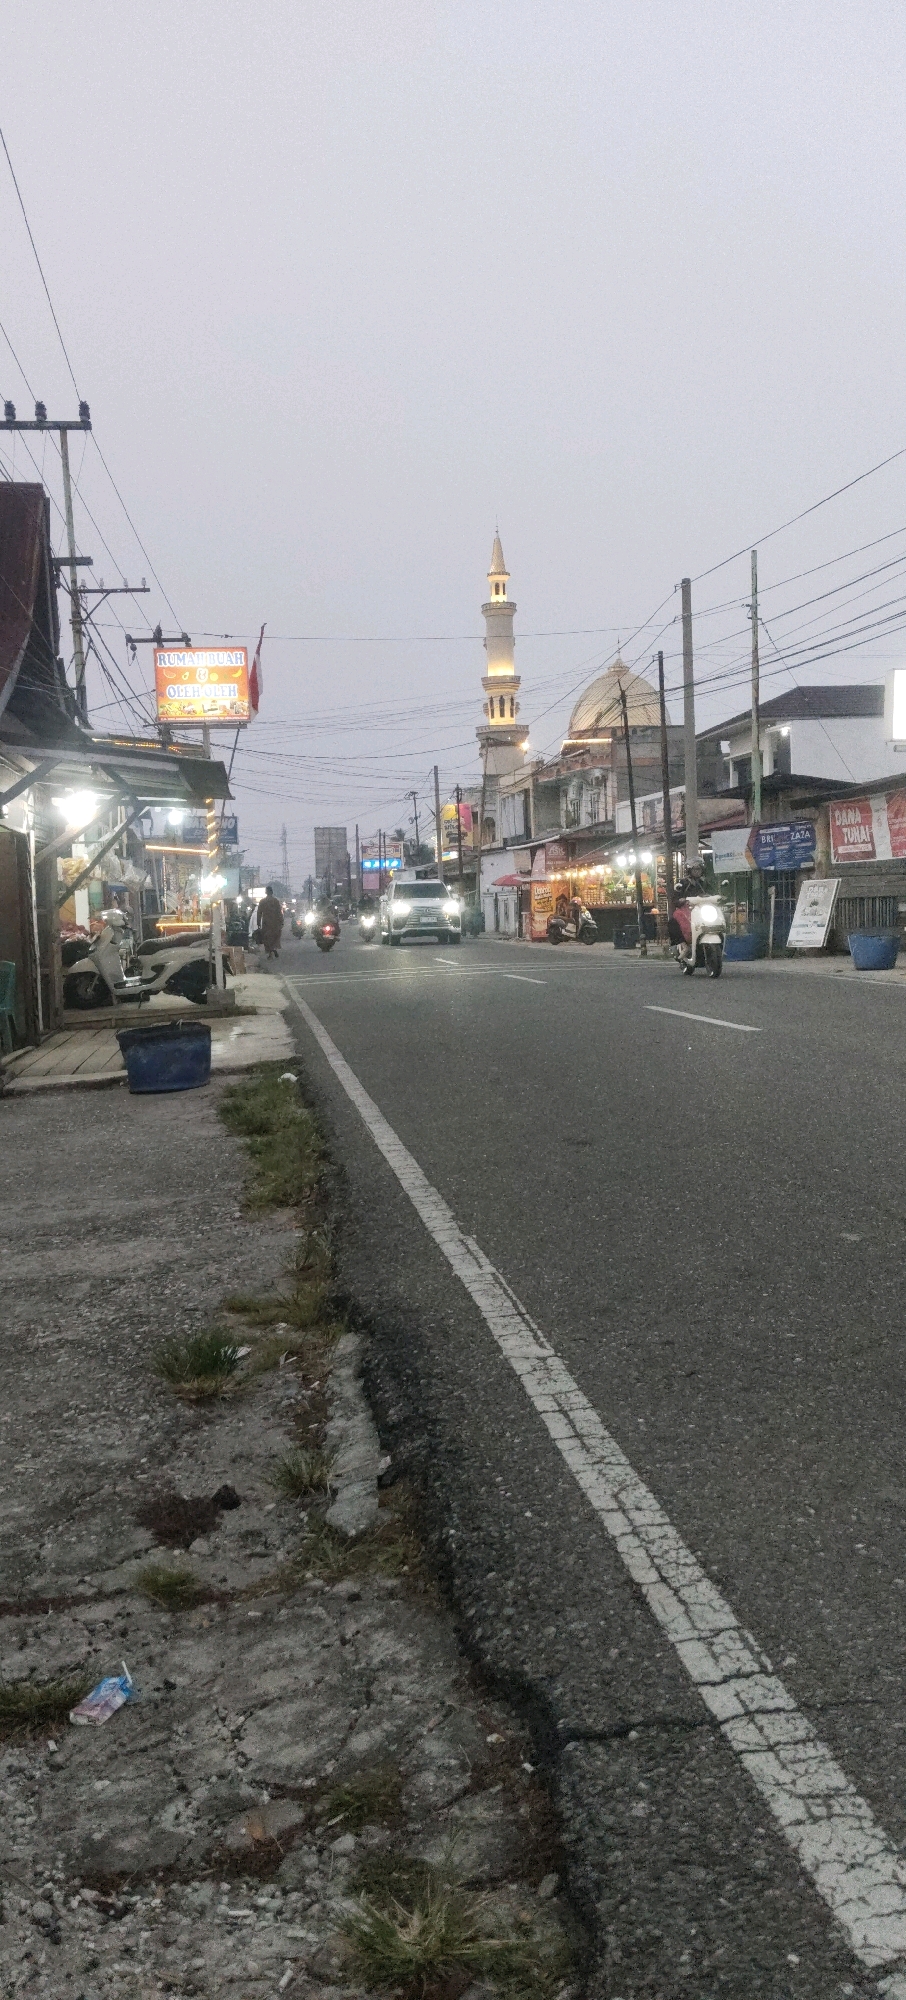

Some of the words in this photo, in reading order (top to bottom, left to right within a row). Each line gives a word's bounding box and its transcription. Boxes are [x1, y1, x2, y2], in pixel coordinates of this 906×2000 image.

[157, 653, 204, 666] RUMAH
[207, 652, 244, 665] BUAH
[835, 808, 861, 827] DANA
[790, 831, 811, 841] ZAZA
[842, 825, 871, 844] TUNAI
